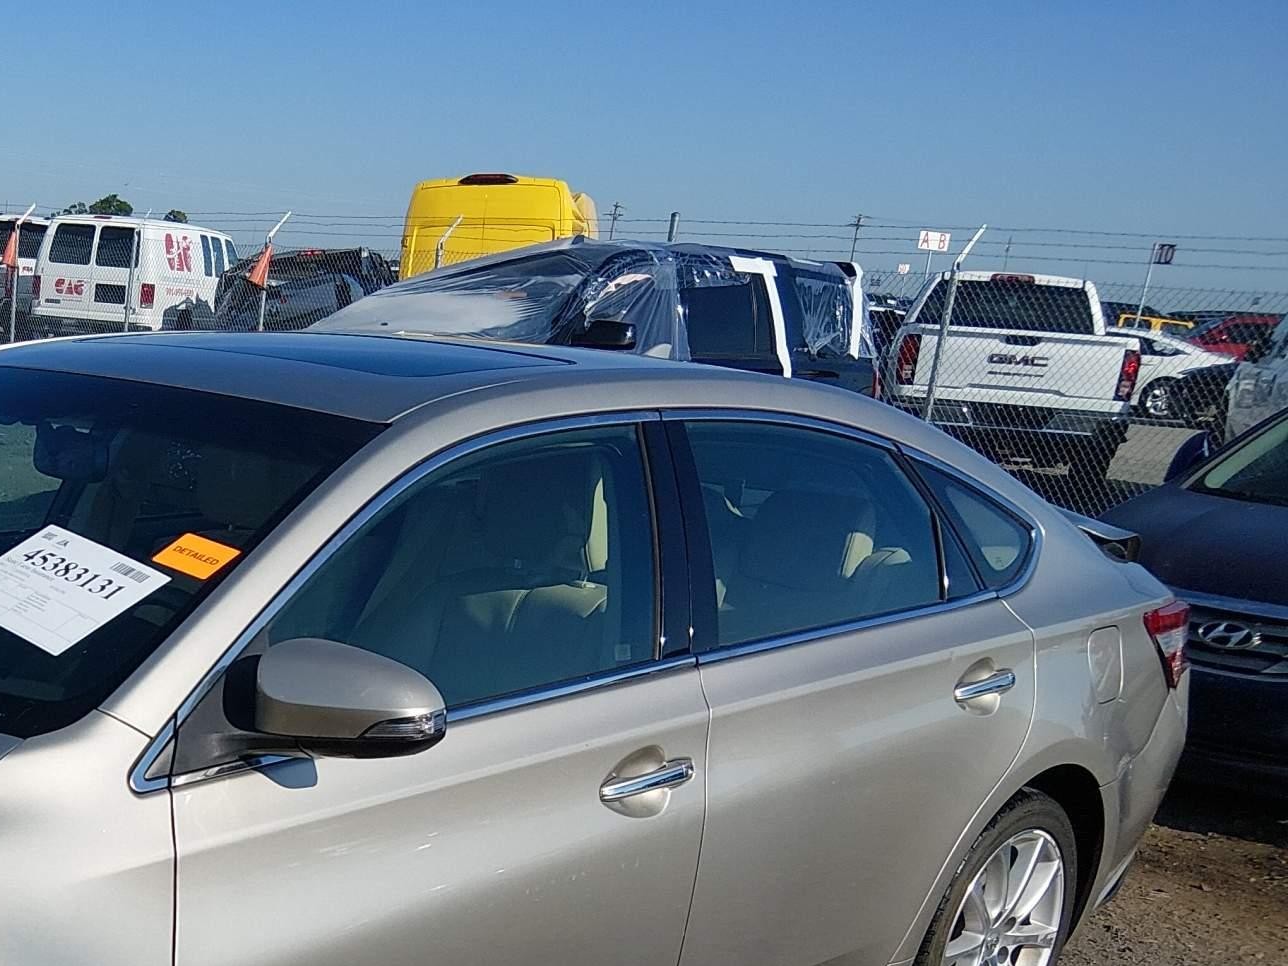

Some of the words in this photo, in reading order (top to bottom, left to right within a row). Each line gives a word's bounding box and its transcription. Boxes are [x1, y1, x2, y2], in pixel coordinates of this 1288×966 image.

[920, 231, 930, 249] A
[938, 233, 947, 249] B
[987, 353, 1049, 367] GMC
[173, 545, 219, 566] DETAILED
[23, 549, 125, 600] 45383131
